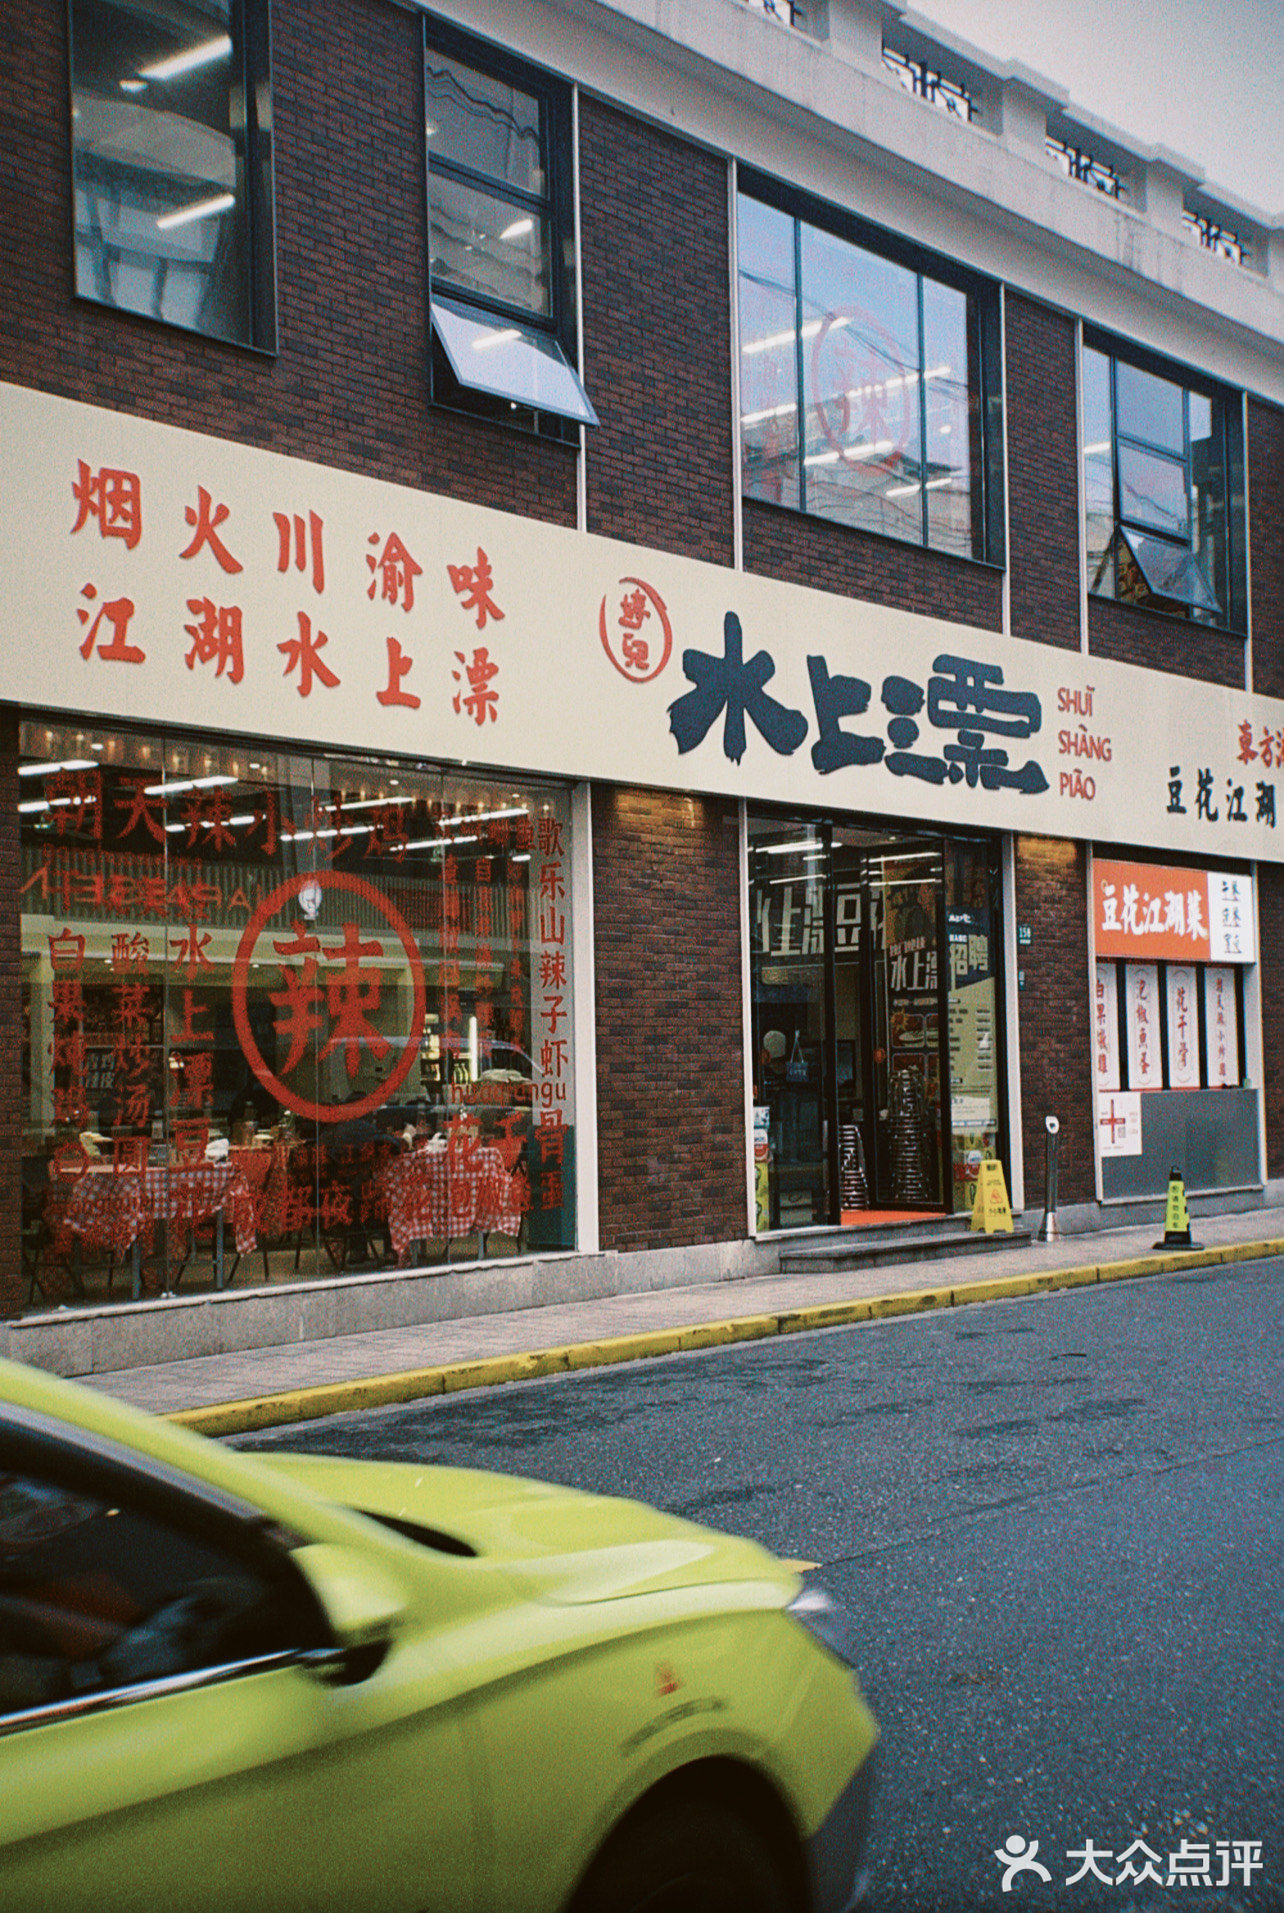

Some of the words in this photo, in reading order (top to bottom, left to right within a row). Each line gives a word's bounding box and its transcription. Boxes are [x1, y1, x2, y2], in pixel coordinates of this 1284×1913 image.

[71, 458, 504, 628] 烟火川渝味
[77, 583, 500, 725] 江湖水上漂
[668, 611, 1050, 794] 水上漂
[1166, 765, 1277, 829] 豆花江湖
[537, 818, 569, 1078] 歌乐山辣子虾
[1101, 883, 1208, 941] 豆花江湖集
[273, 920, 394, 1078] 辣
[443, 1110, 569, 1172] 花千骨
